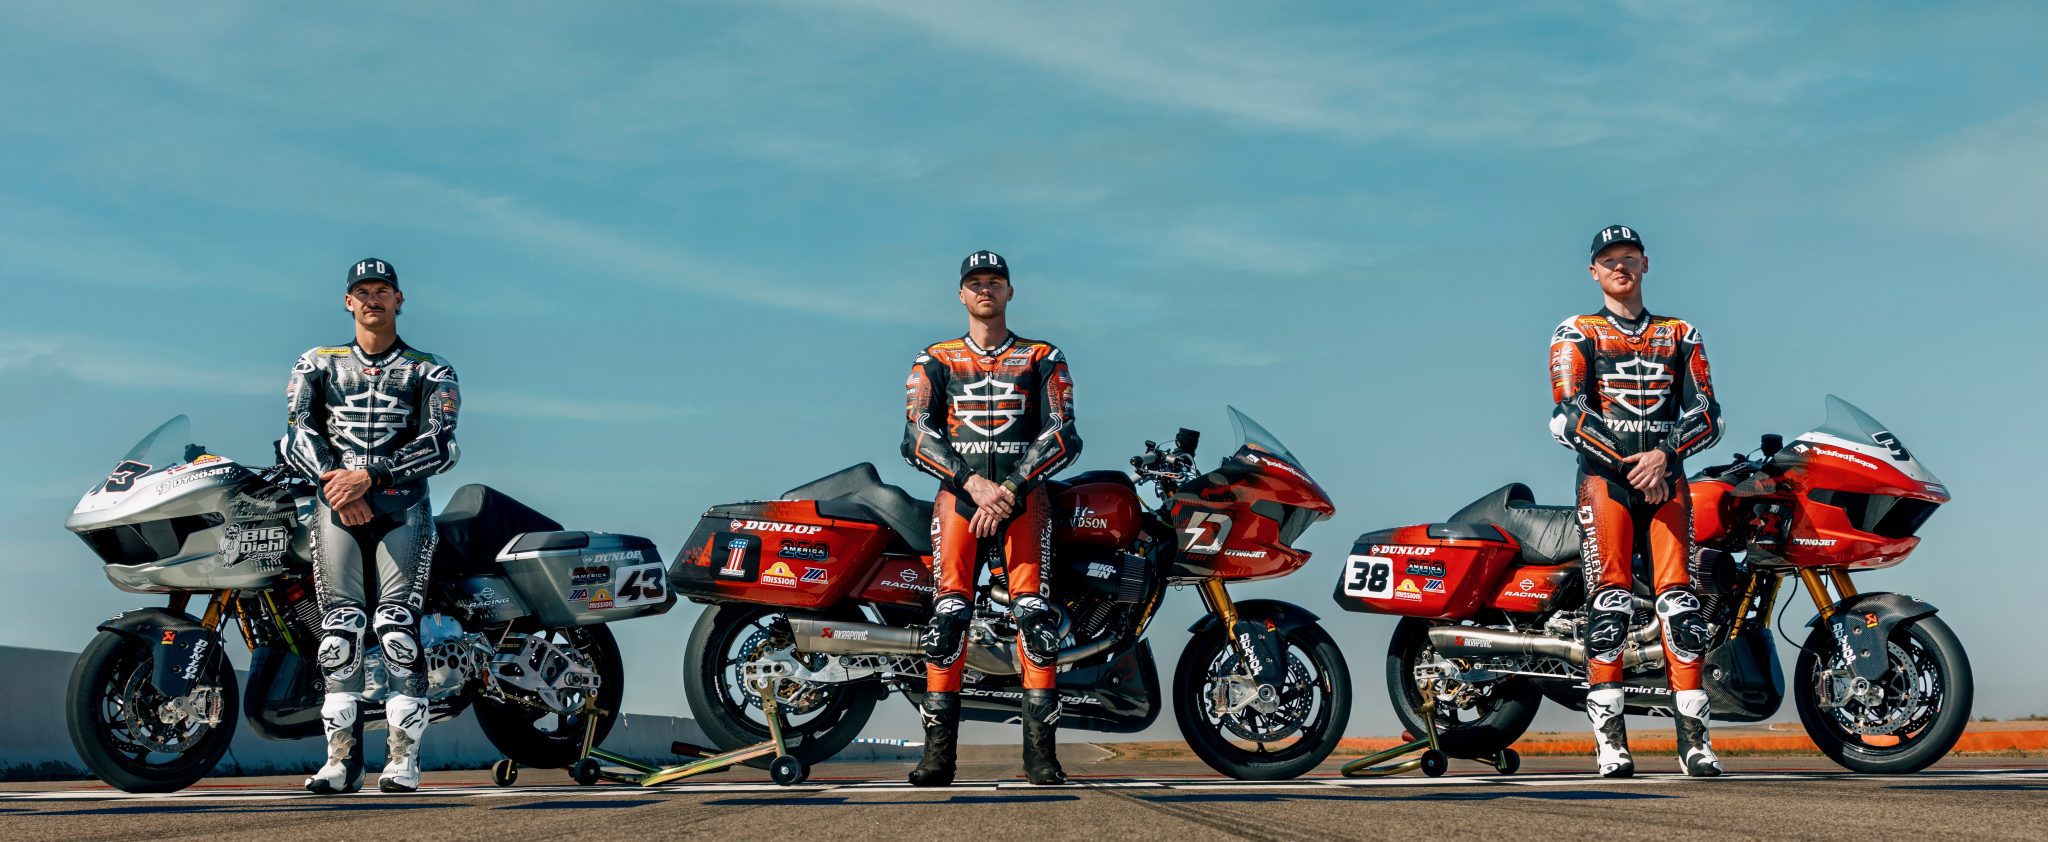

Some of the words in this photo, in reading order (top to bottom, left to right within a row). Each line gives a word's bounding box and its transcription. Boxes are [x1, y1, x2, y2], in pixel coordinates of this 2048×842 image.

[1602, 226, 1631, 243] H-D
[969, 253, 998, 267] H-D
[356, 261, 386, 276] H-D
[951, 441, 1029, 454] DYNOJET
[173, 466, 232, 488] DYNOJET
[744, 520, 822, 535] DUNLOP
[241, 528, 285, 542] BIG
[241, 539, 284, 553] Diehl
[783, 546, 824, 554] AMERICA
[1380, 545, 1436, 556] DUNLOP
[593, 550, 641, 563] DUNLOP
[762, 576, 795, 586] mission
[1348, 561, 1390, 592] 38
[617, 567, 664, 601] 43
[880, 581, 934, 592] RACING
[1504, 591, 1548, 599] RACING
[469, 597, 510, 608] RACING
[589, 601, 613, 609] mission
[1239, 632, 1263, 676] DUNLOP
[1058, 694, 1102, 705] agle
